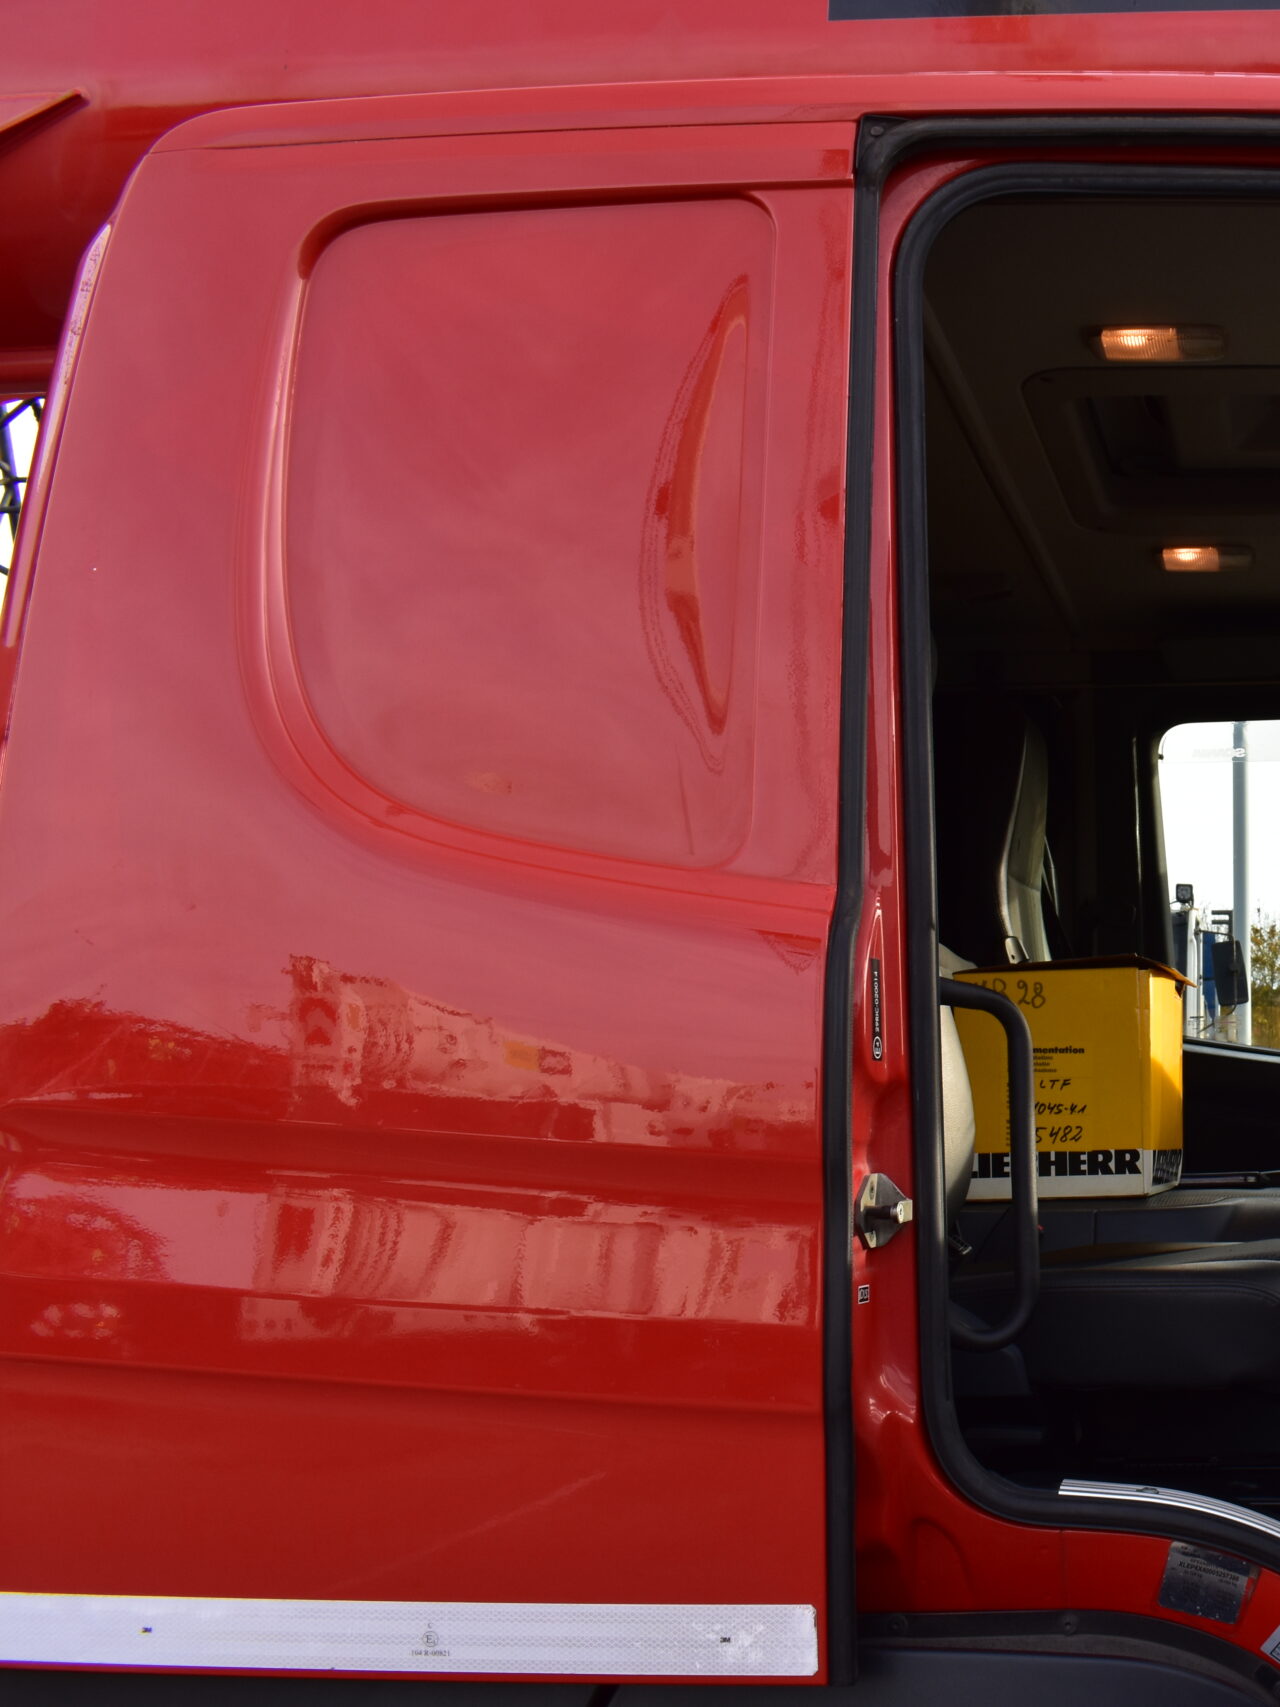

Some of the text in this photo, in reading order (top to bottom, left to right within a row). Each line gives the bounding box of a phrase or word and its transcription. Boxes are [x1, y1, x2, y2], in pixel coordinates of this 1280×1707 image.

[1017, 979, 1046, 1009] 28
[1032, 1045, 1085, 1054] mentation
[1039, 1078, 1072, 1091] LTF
[971, 1149, 1142, 1179] IEHERR
